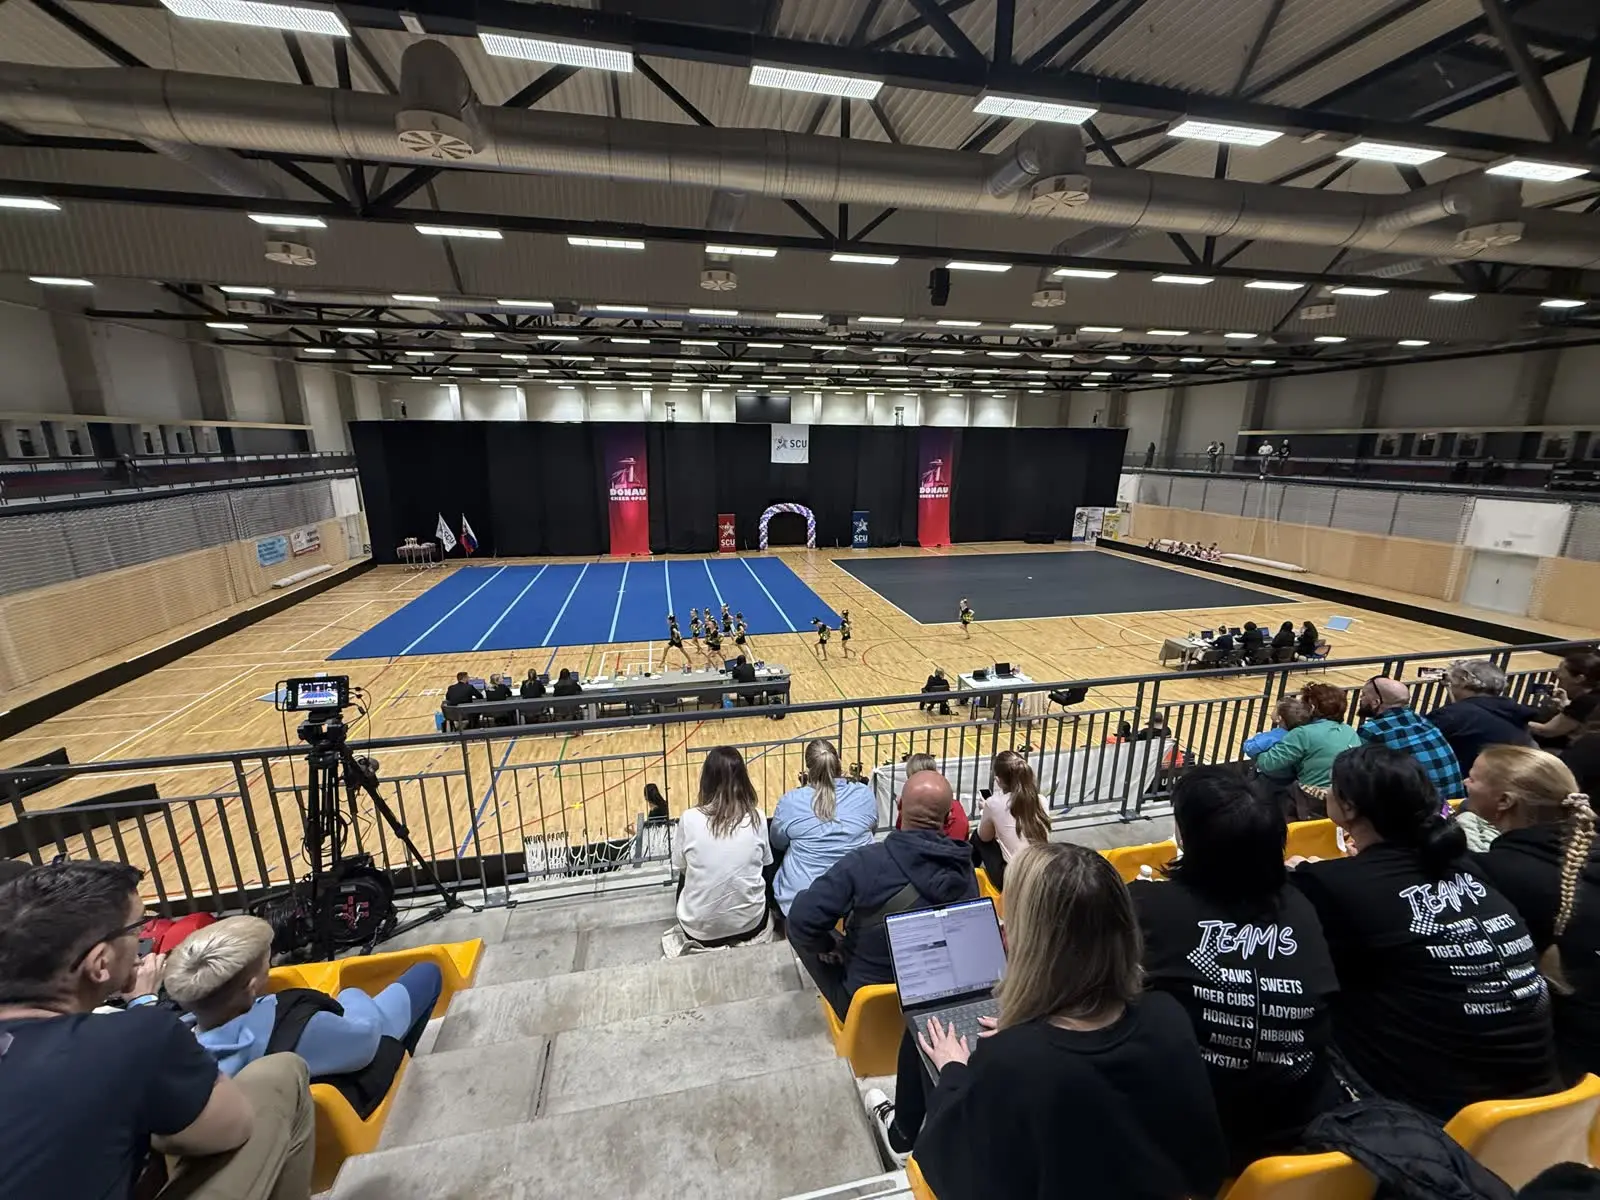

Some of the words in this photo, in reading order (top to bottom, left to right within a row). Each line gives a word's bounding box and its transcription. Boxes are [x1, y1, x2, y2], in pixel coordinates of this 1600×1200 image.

[790, 439, 807, 448] SCU
[609, 488, 646, 496] DONAU
[720, 538, 736, 546] SCU
[853, 534, 868, 542] SCU
[1399, 872, 1487, 921] TEAMS
[1482, 913, 1516, 934] SWEETS
[1198, 920, 1297, 960] TEAMS
[1426, 944, 1465, 959] TIGER
[1463, 939, 1494, 956] CUBS
[1220, 967, 1253, 984] PAWS
[1260, 977, 1304, 995] SWEETS
[1192, 985, 1225, 1004] TIGER
[1226, 992, 1256, 1008] CUBS
[1262, 1003, 1316, 1020] LADYBUGS
[1463, 1000, 1512, 1015] CRYSTALS
[1203, 1007, 1255, 1029] HORNETS
[1209, 1032, 1252, 1050] ANGELS
[1260, 1028, 1305, 1043] RIBBONS
